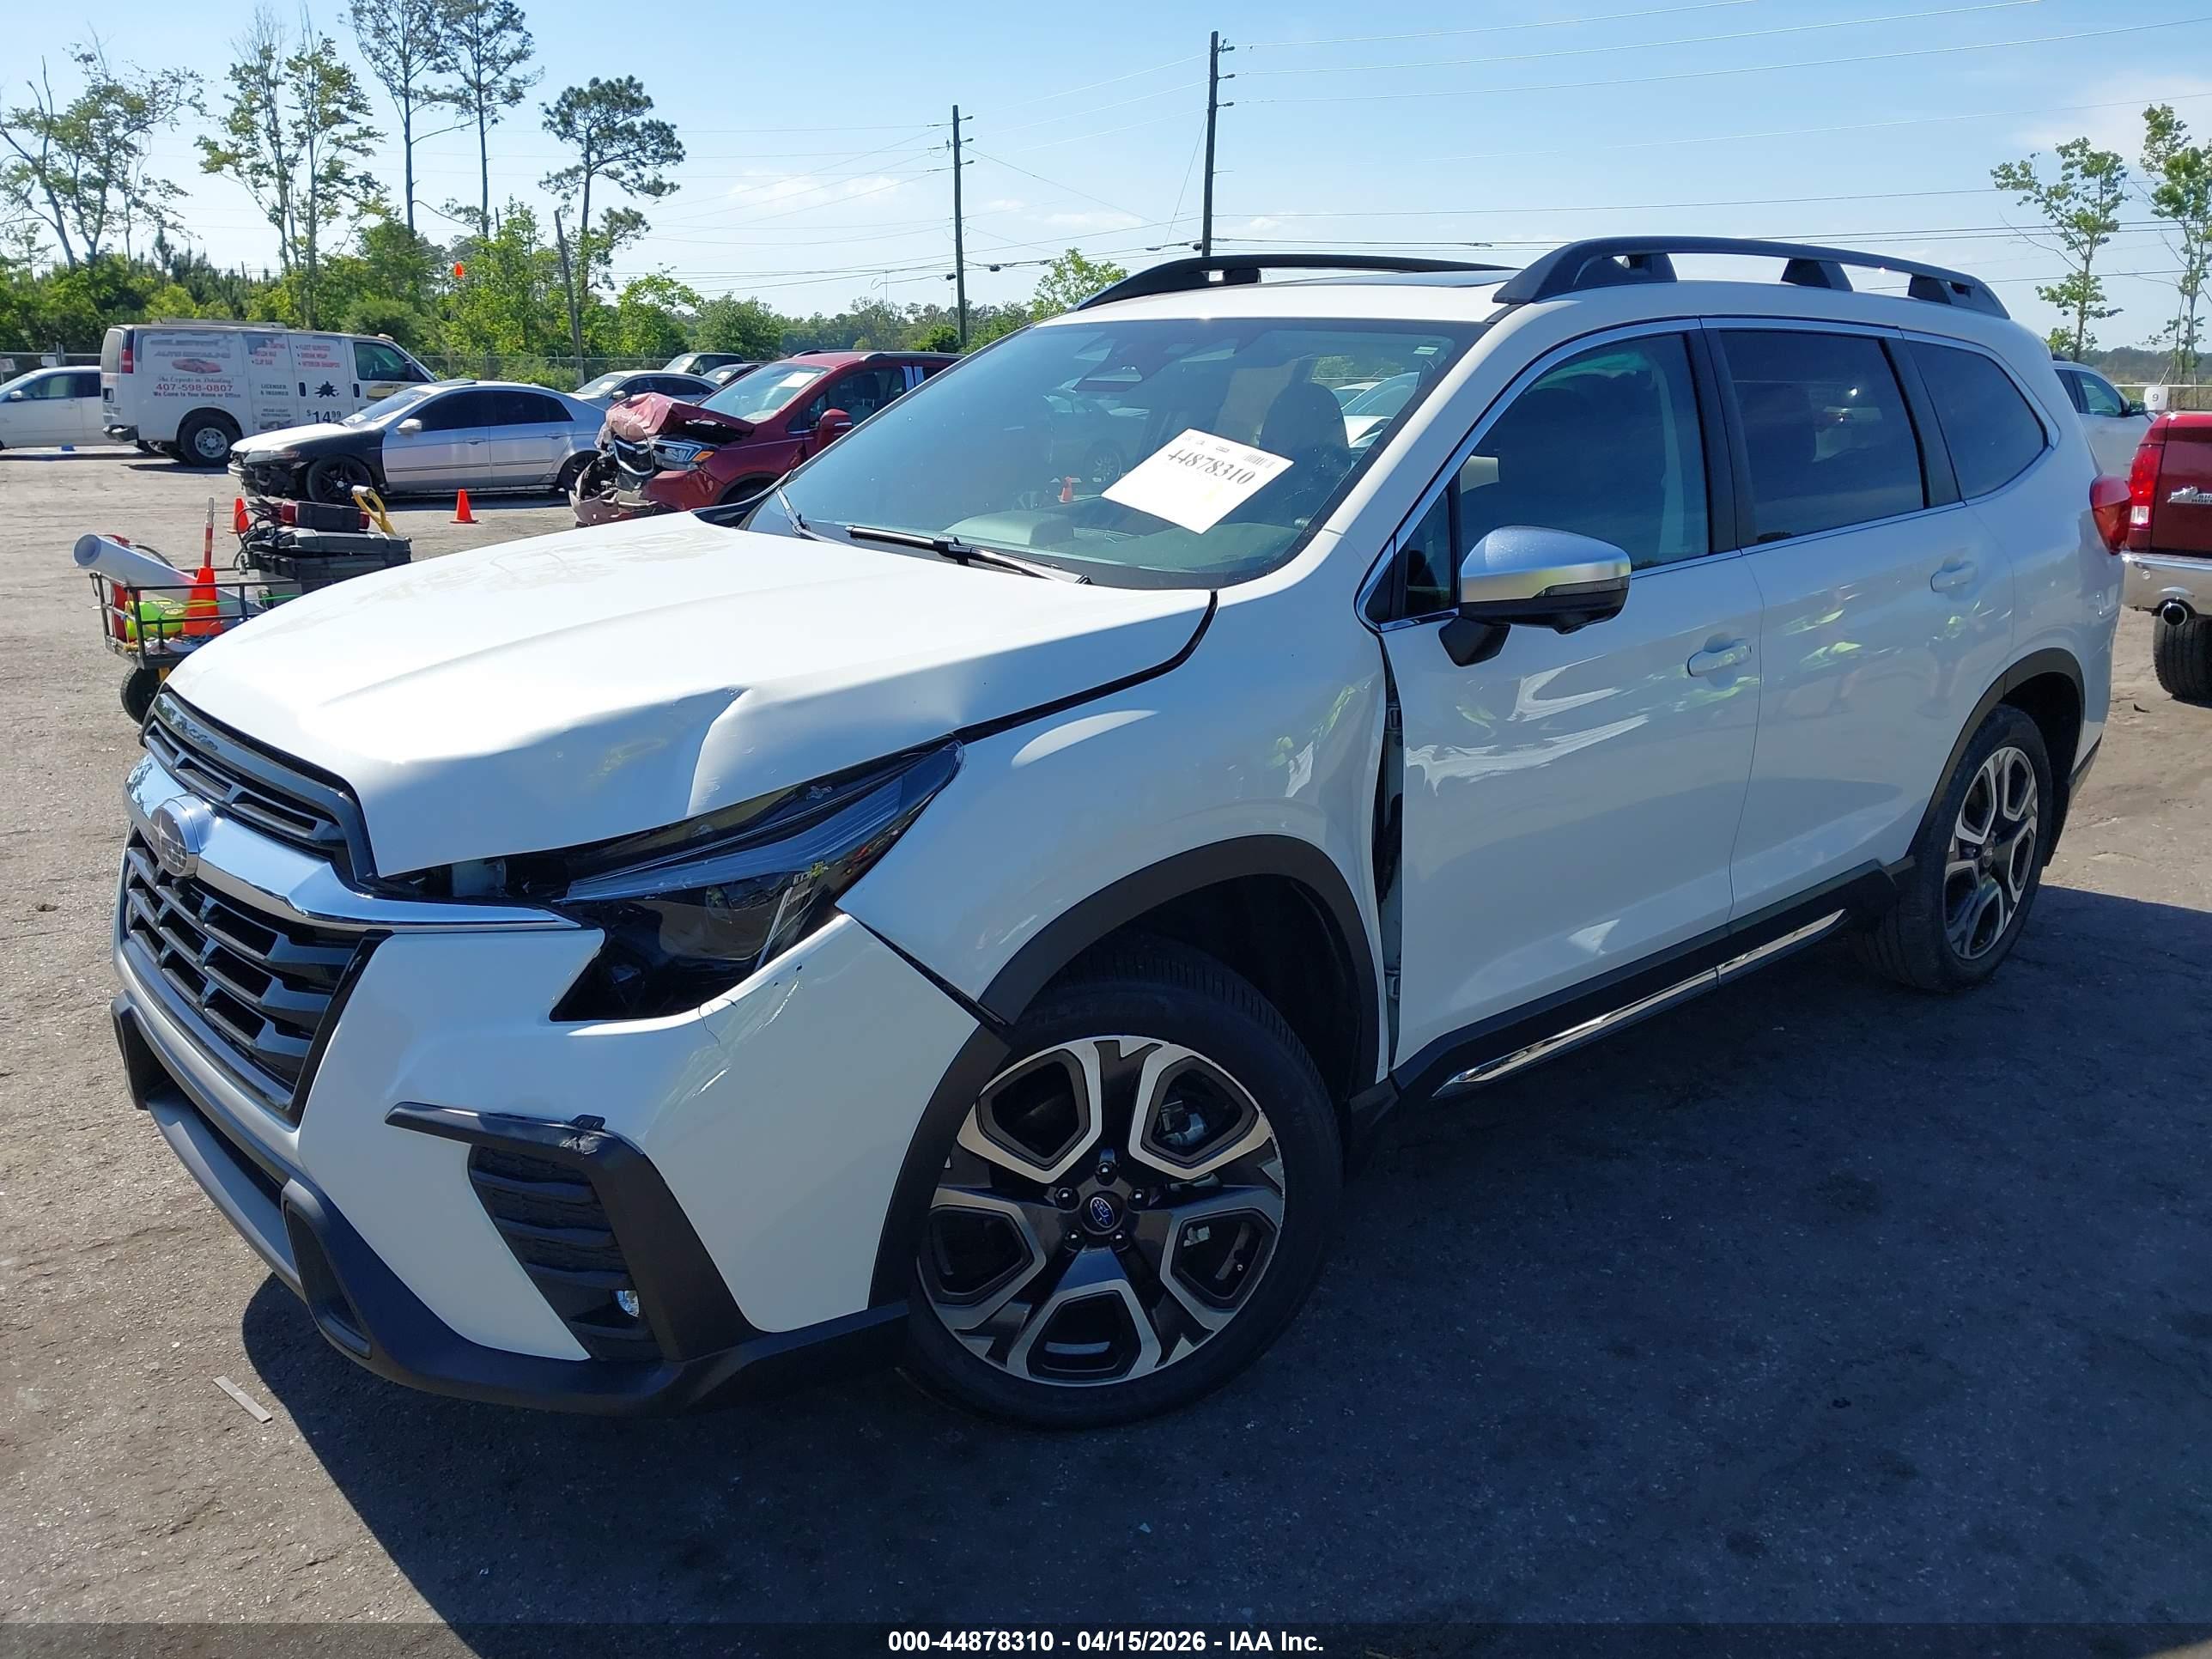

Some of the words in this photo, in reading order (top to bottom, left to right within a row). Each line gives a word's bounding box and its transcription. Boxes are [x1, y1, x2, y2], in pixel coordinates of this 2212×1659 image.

[155, 383, 234, 392] 407-598-0807
[2152, 393, 2159, 402] 9
[1167, 448, 1256, 485] 44878310
